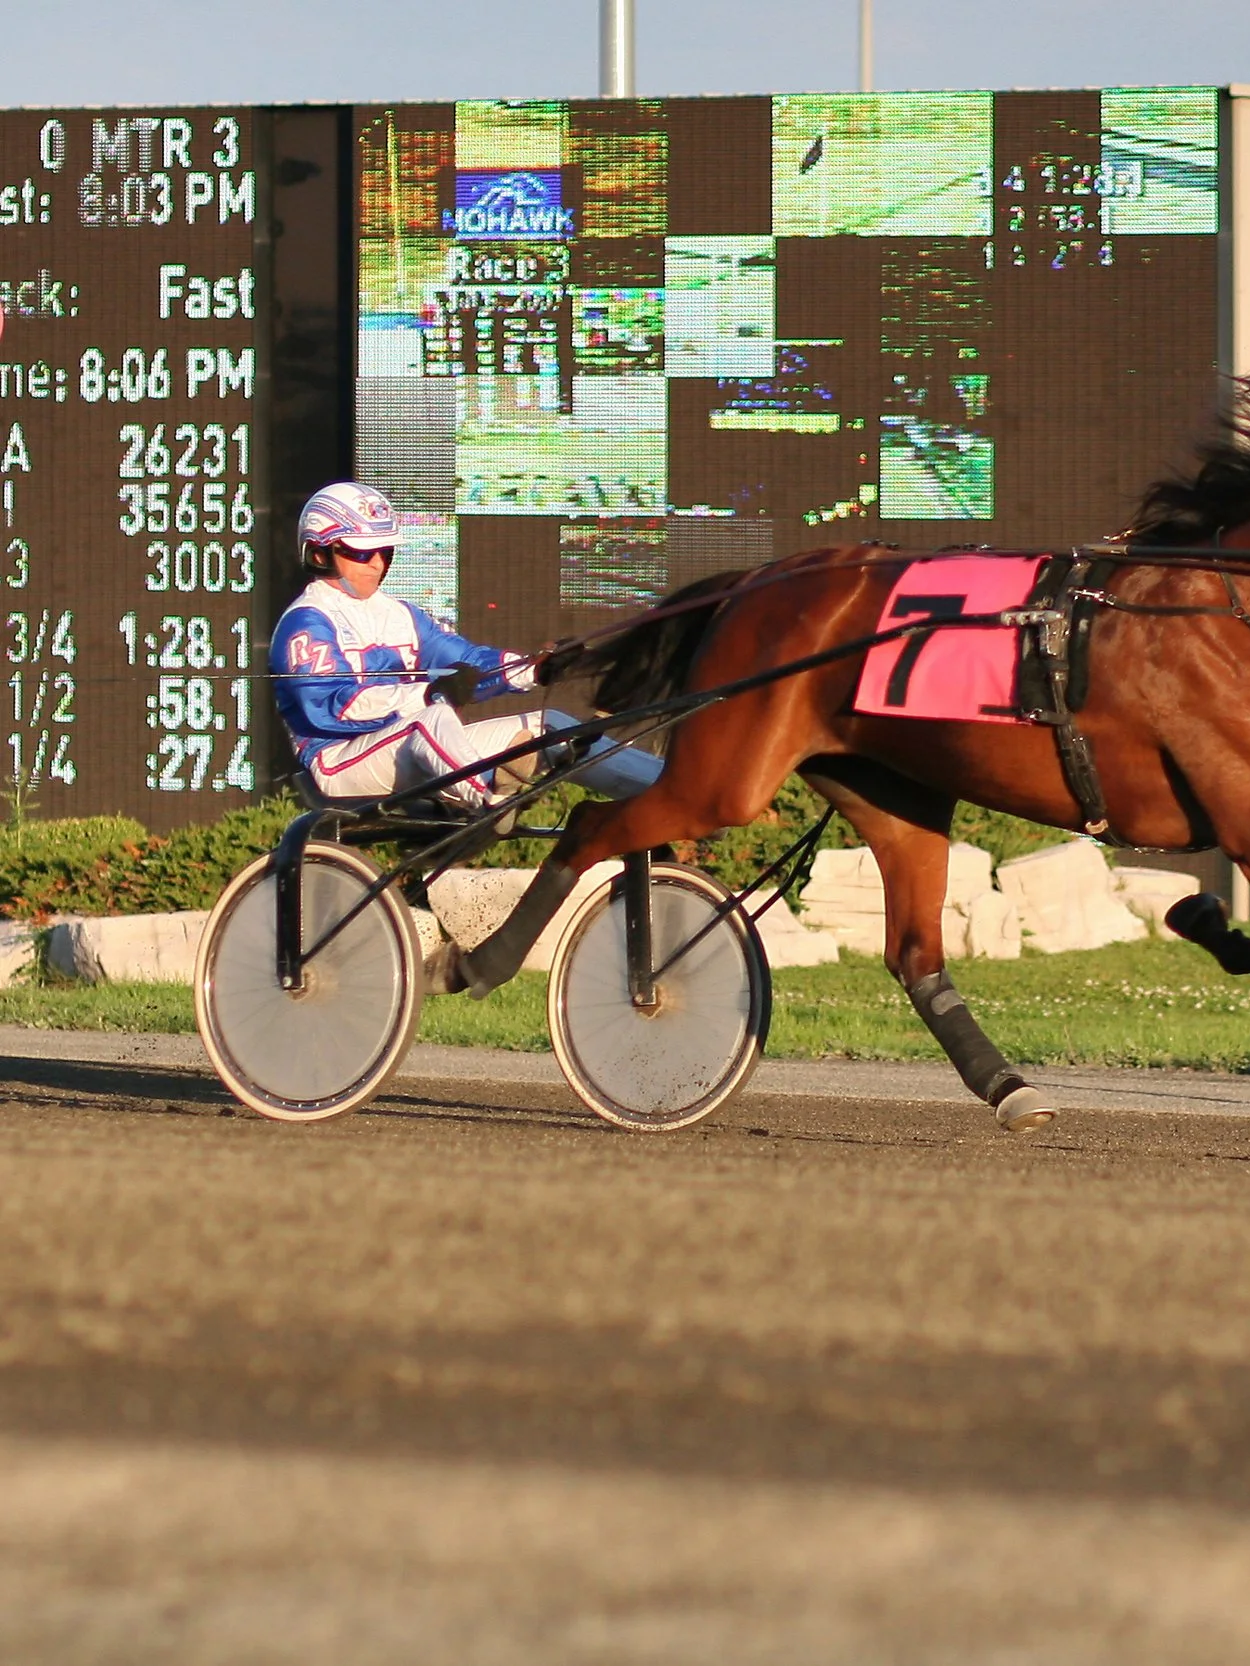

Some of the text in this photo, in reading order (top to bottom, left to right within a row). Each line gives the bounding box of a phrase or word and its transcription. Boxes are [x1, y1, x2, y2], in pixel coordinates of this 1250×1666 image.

[93, 117, 193, 173] MTR
[213, 117, 240, 168] 3
[185, 171, 256, 224] PM
[160, 264, 256, 319] Fast
[80, 347, 171, 402] 8:06
[187, 348, 256, 399] PM
[0, 422, 252, 478] A 26231
[118, 482, 255, 536] 35656
[6, 537, 254, 592] 3 3003
[6, 608, 251, 668] 3/4 1:28.1
[287, 630, 337, 675] RZ
[884, 594, 968, 707] 7
[8, 668, 251, 731] 1/2 :58.1
[8, 730, 255, 792] 1/4 :27.4
